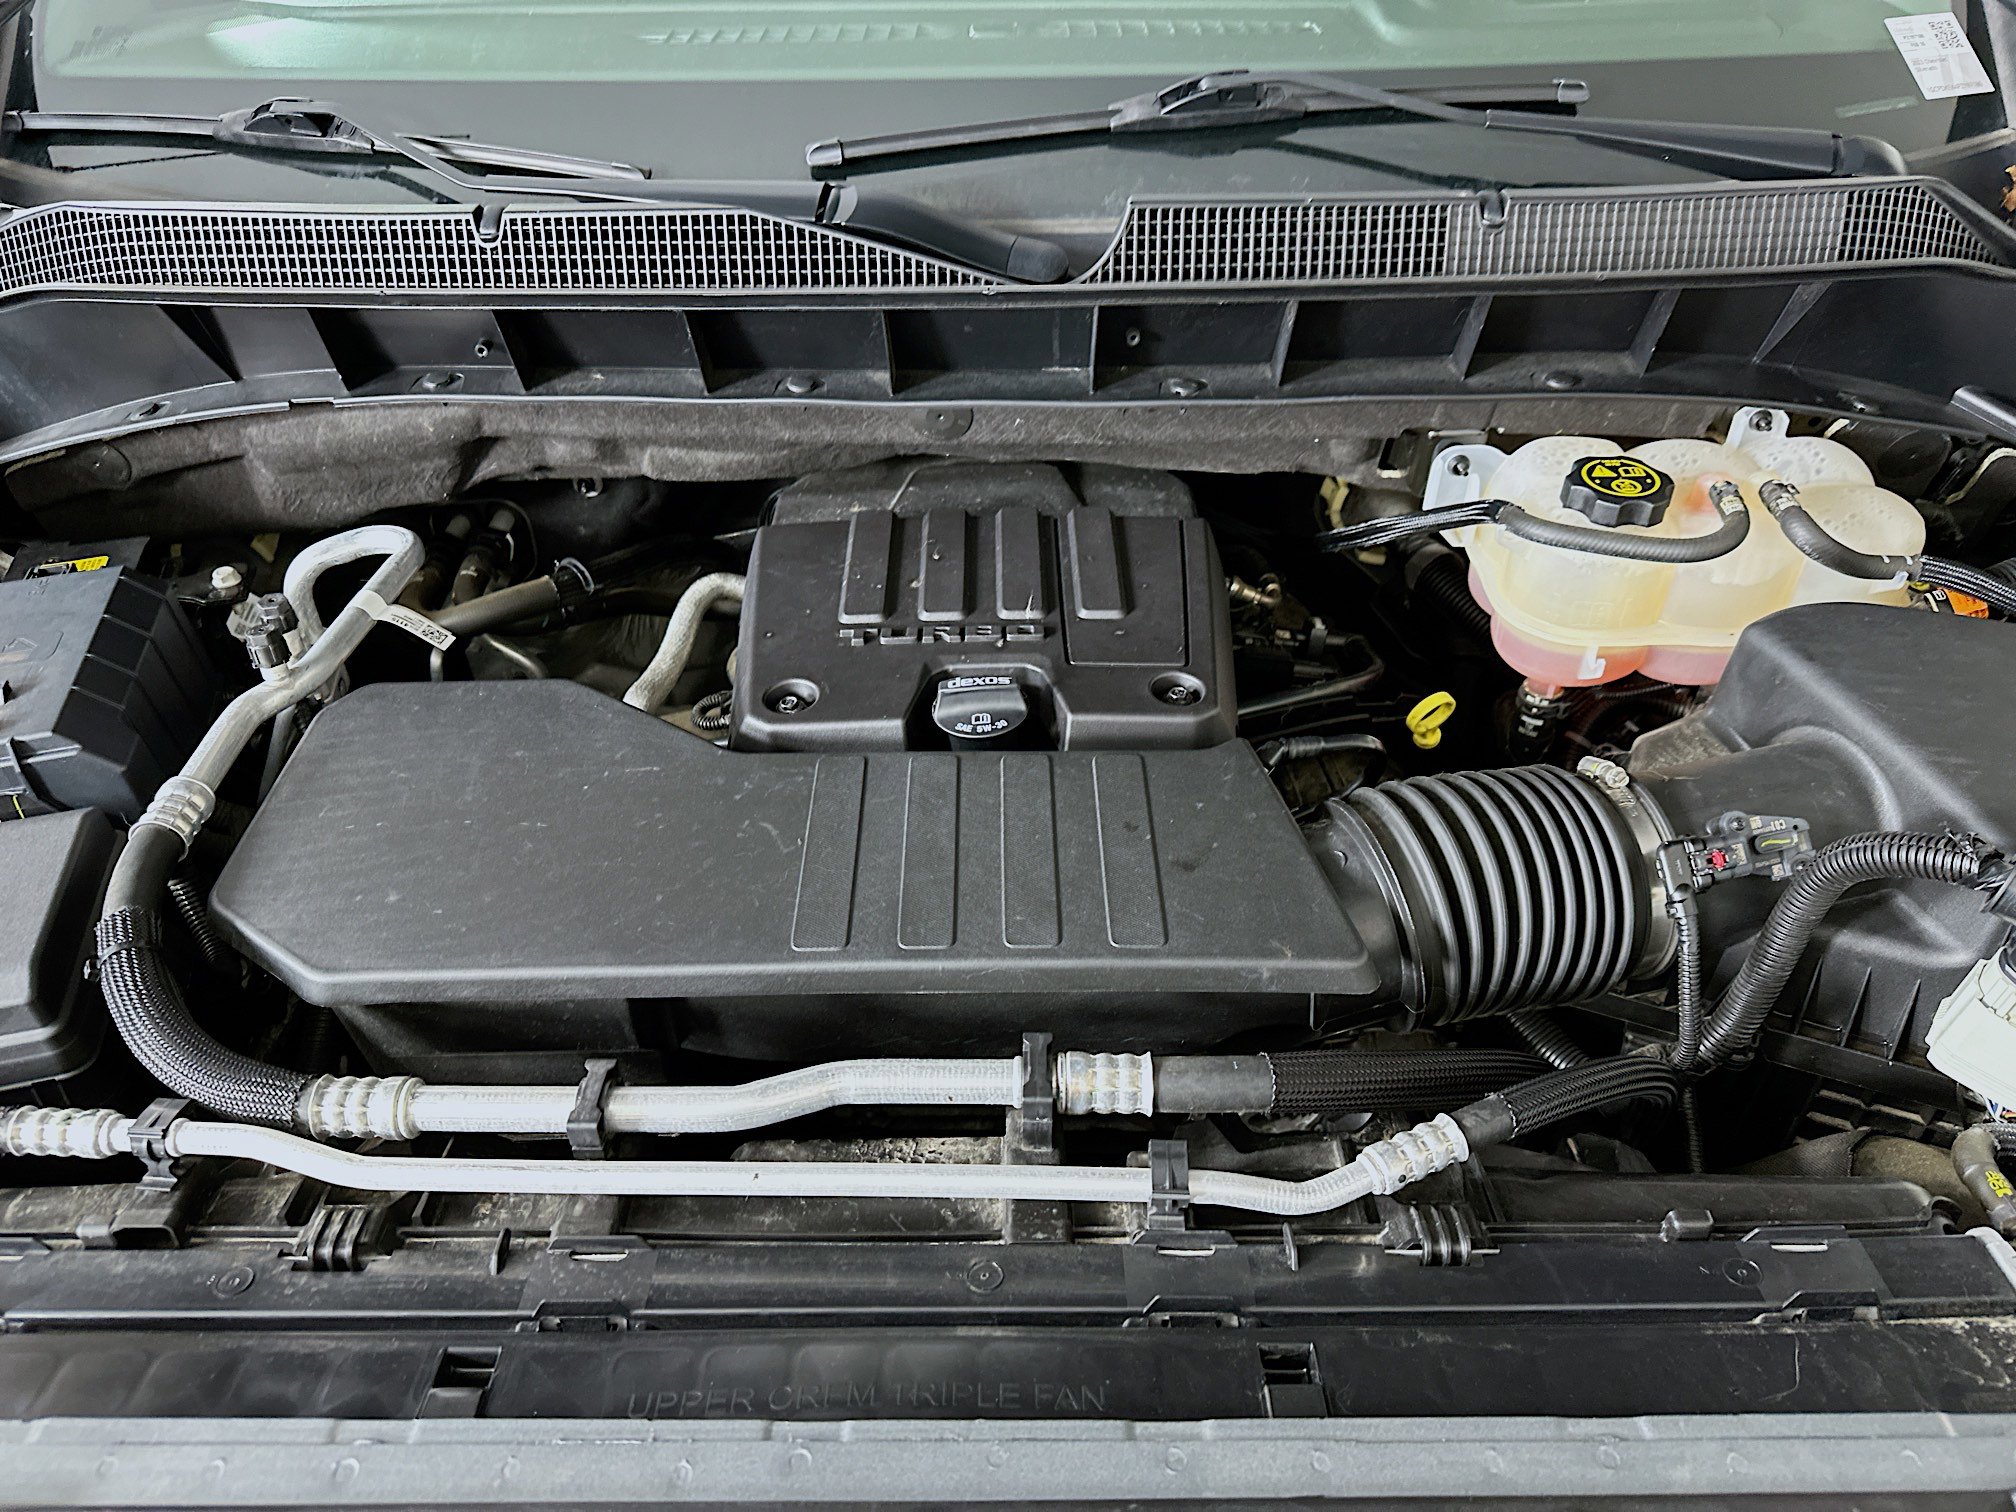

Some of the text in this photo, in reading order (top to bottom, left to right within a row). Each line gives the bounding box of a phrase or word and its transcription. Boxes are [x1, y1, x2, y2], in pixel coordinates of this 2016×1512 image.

[838, 625, 1045, 647] TURBO
[947, 675, 1012, 689] dexos
[955, 719, 1008, 733] SAE 5W-30
[626, 1386, 756, 1418] UPPER
[888, 1380, 1021, 1410] TRIPLE
[1034, 1381, 1106, 1413] FAN
